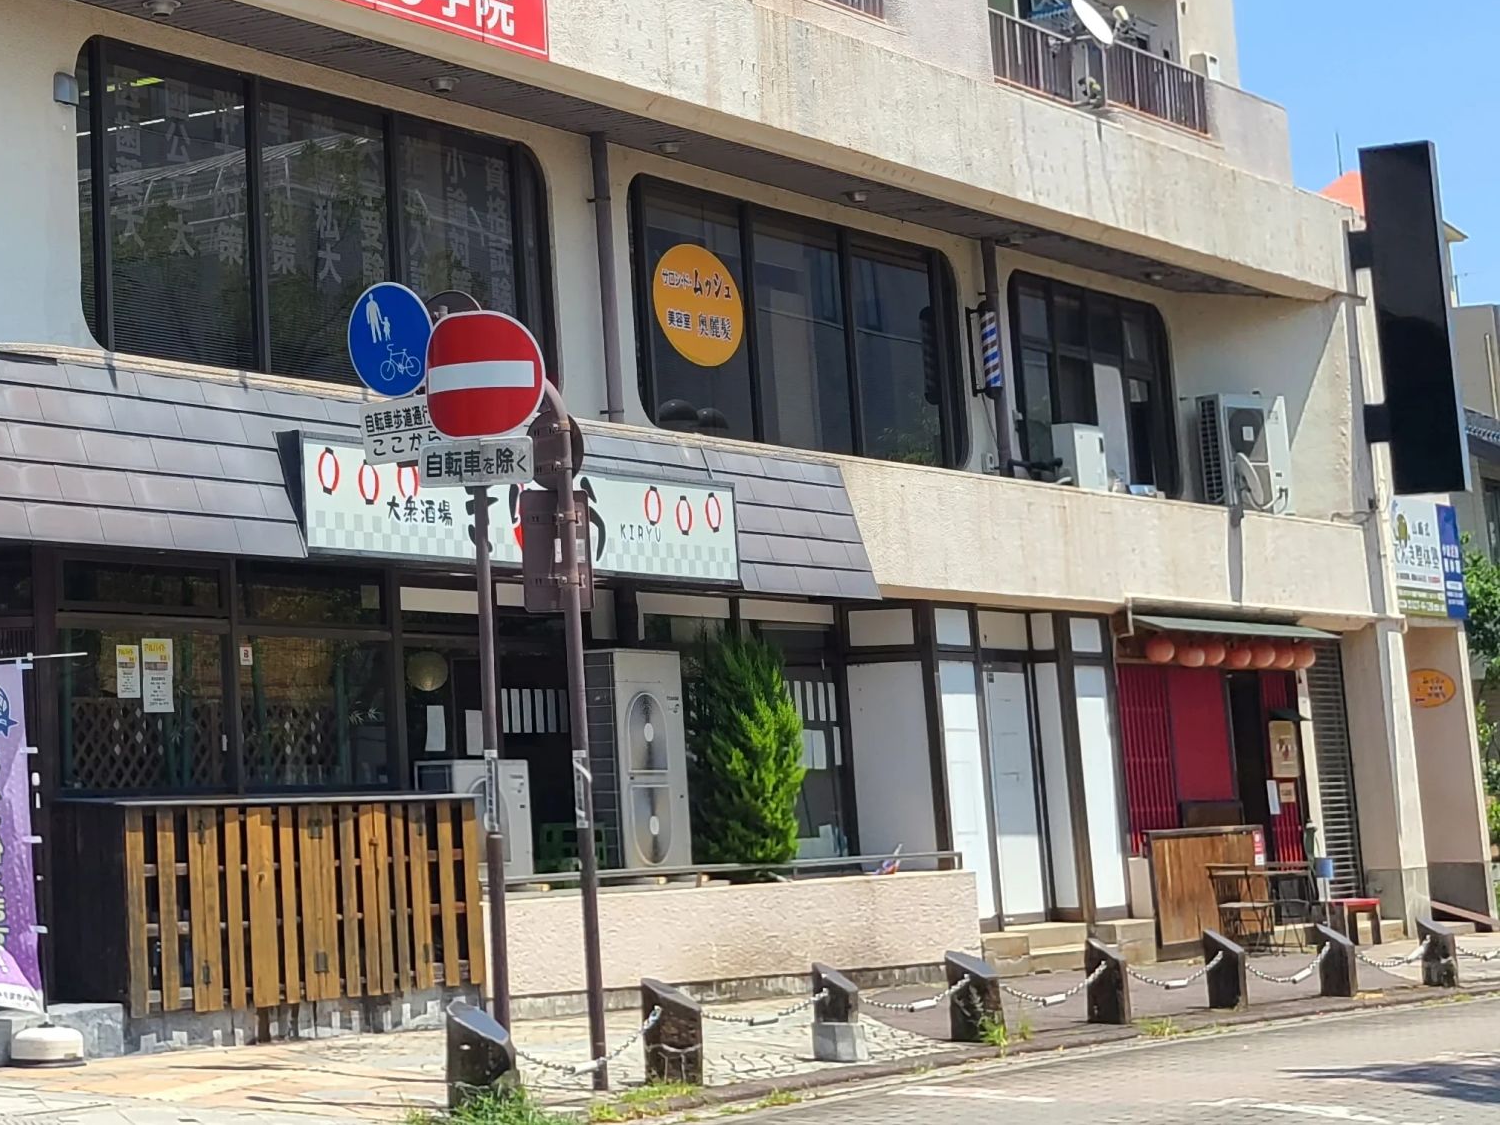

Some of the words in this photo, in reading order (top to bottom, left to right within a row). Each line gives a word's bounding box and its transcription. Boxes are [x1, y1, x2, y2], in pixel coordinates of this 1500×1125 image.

[668, 310, 692, 330] 美容室
[426, 447, 528, 478] 自転車を除く
[386, 493, 453, 527] 大衆酒場
[620, 524, 662, 544] KIRYU
